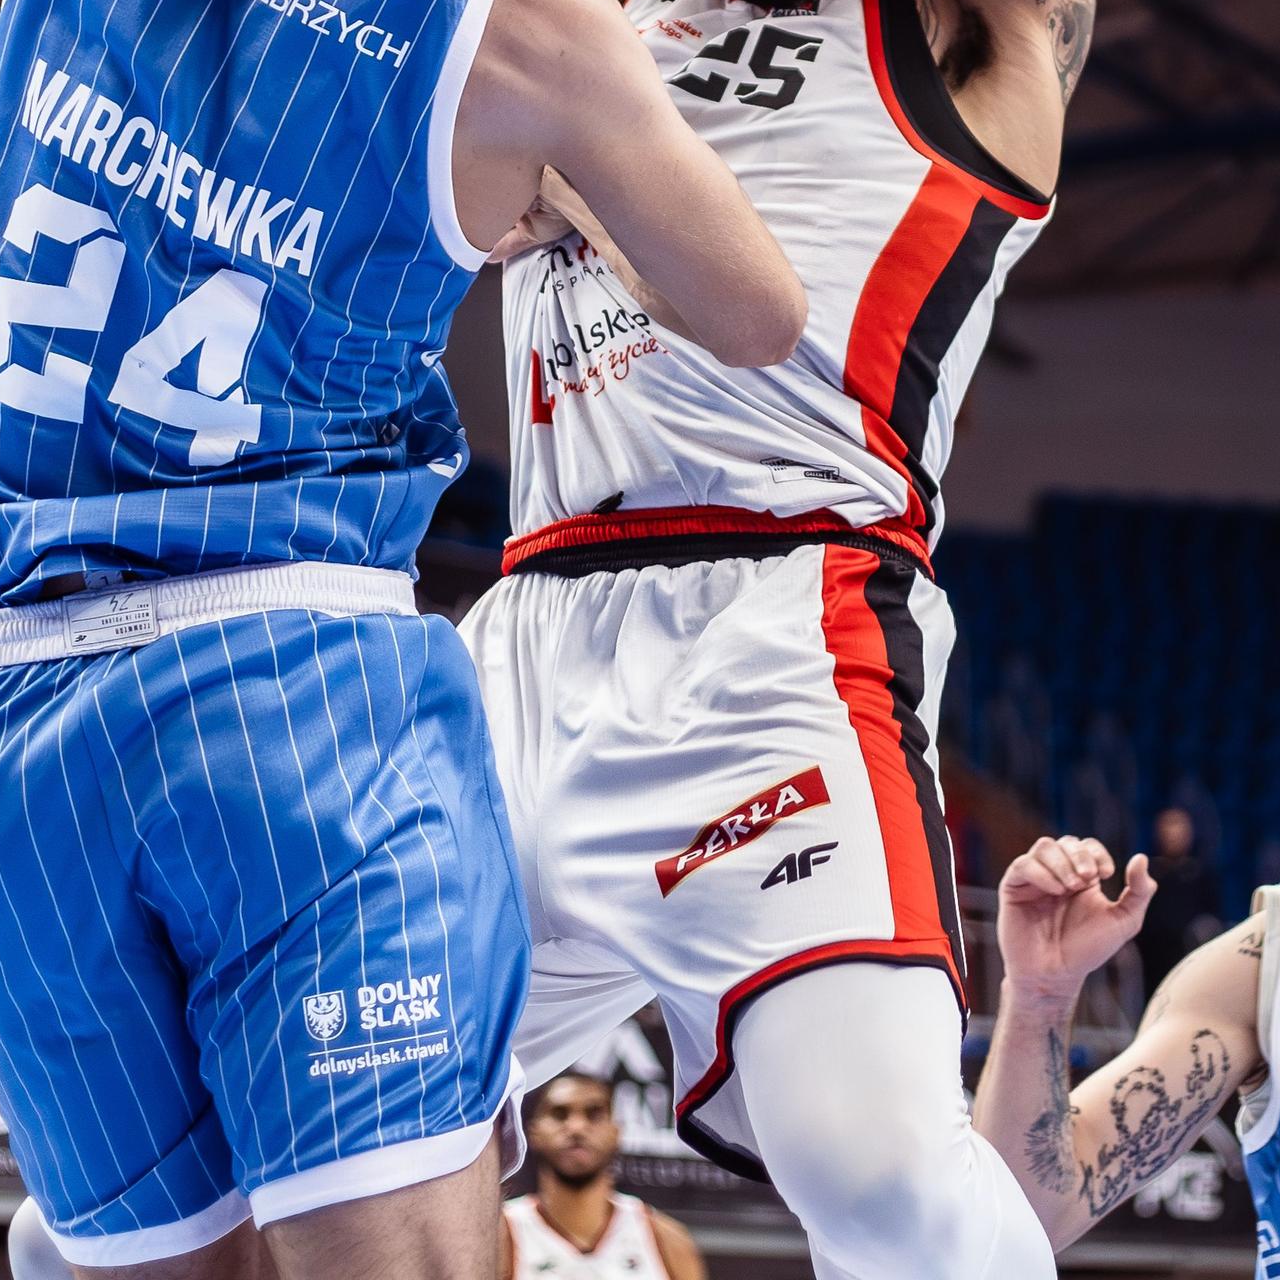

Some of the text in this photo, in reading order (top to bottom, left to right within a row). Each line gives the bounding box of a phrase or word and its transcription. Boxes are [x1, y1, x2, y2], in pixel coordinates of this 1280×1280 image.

[672, 18, 704, 39] asket
[665, 23, 825, 111] 25
[21, 56, 326, 278] MARCHEWKA
[676, 784, 805, 873] PERŁA
[759, 841, 839, 891] 4F
[357, 973, 442, 1008] DOLNY
[360, 996, 442, 1030] ŚLĄSK
[308, 1037, 450, 1077] dolnyslask.travel
